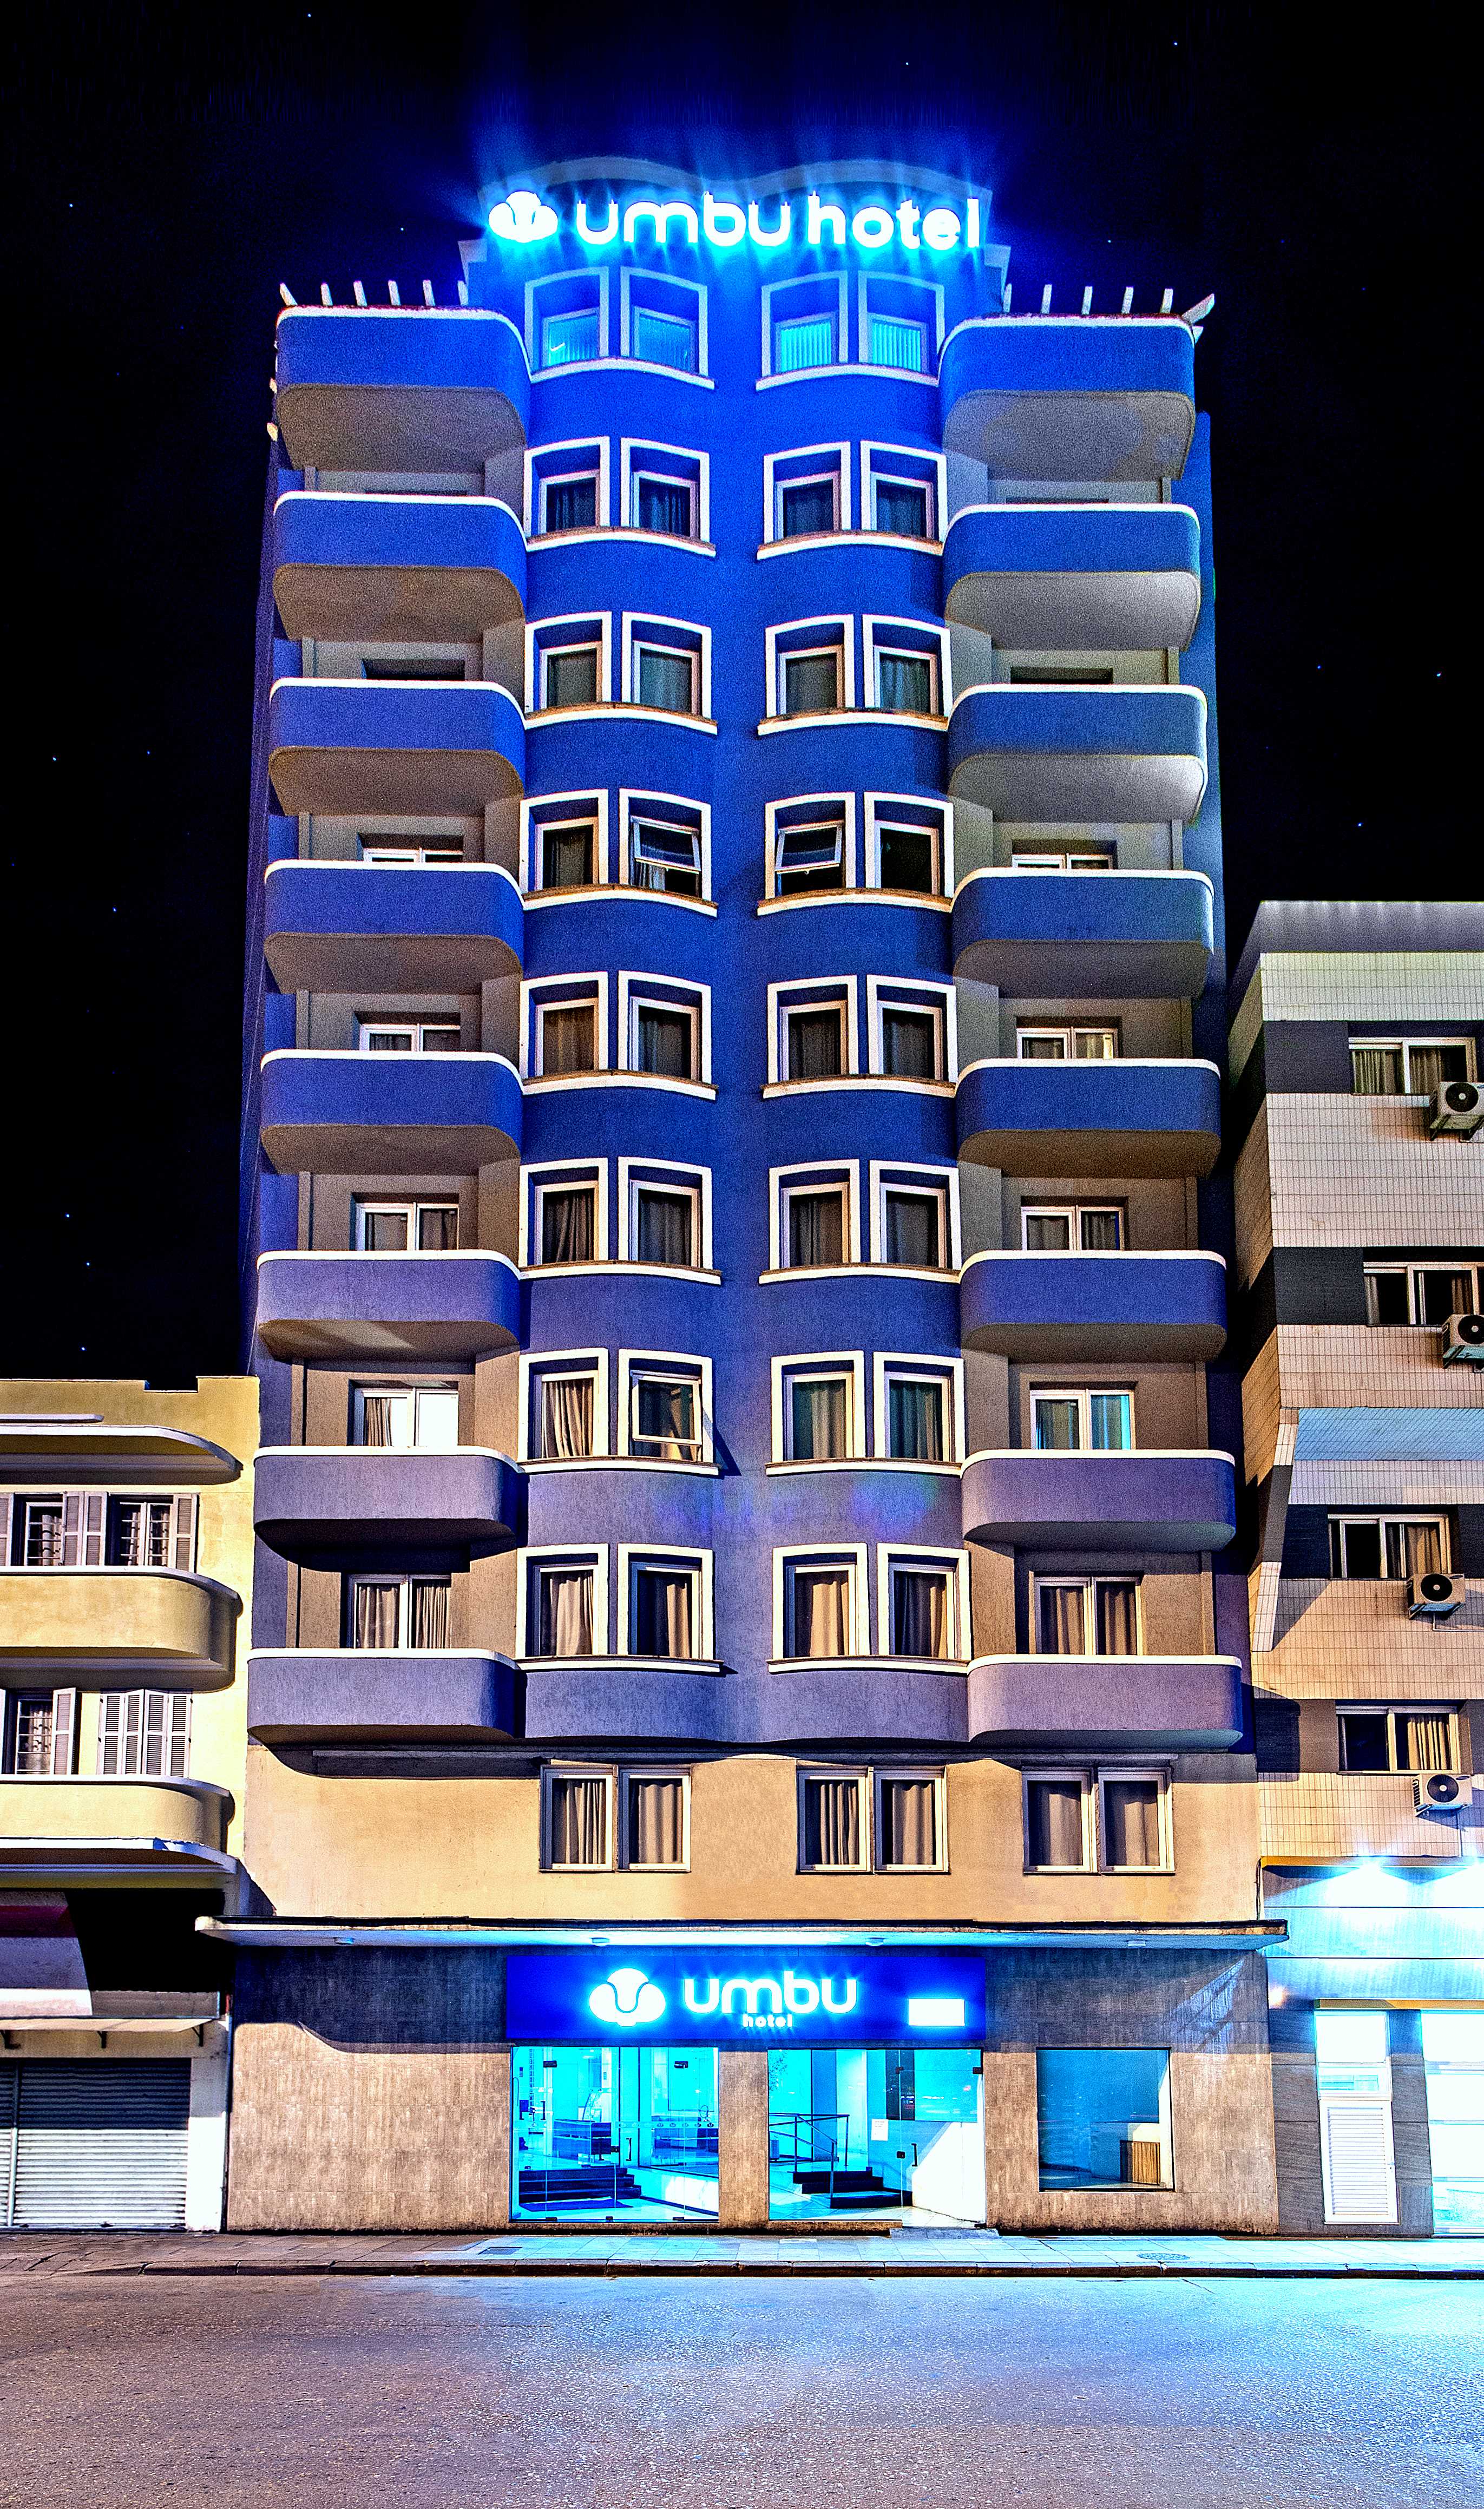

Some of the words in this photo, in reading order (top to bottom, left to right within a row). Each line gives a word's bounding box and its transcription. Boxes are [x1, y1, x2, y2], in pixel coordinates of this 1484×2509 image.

[576, 192, 791, 246] umbu
[807, 192, 980, 250] hotel
[684, 1971, 857, 2014] umbu
[742, 2014, 793, 2027] hotel
